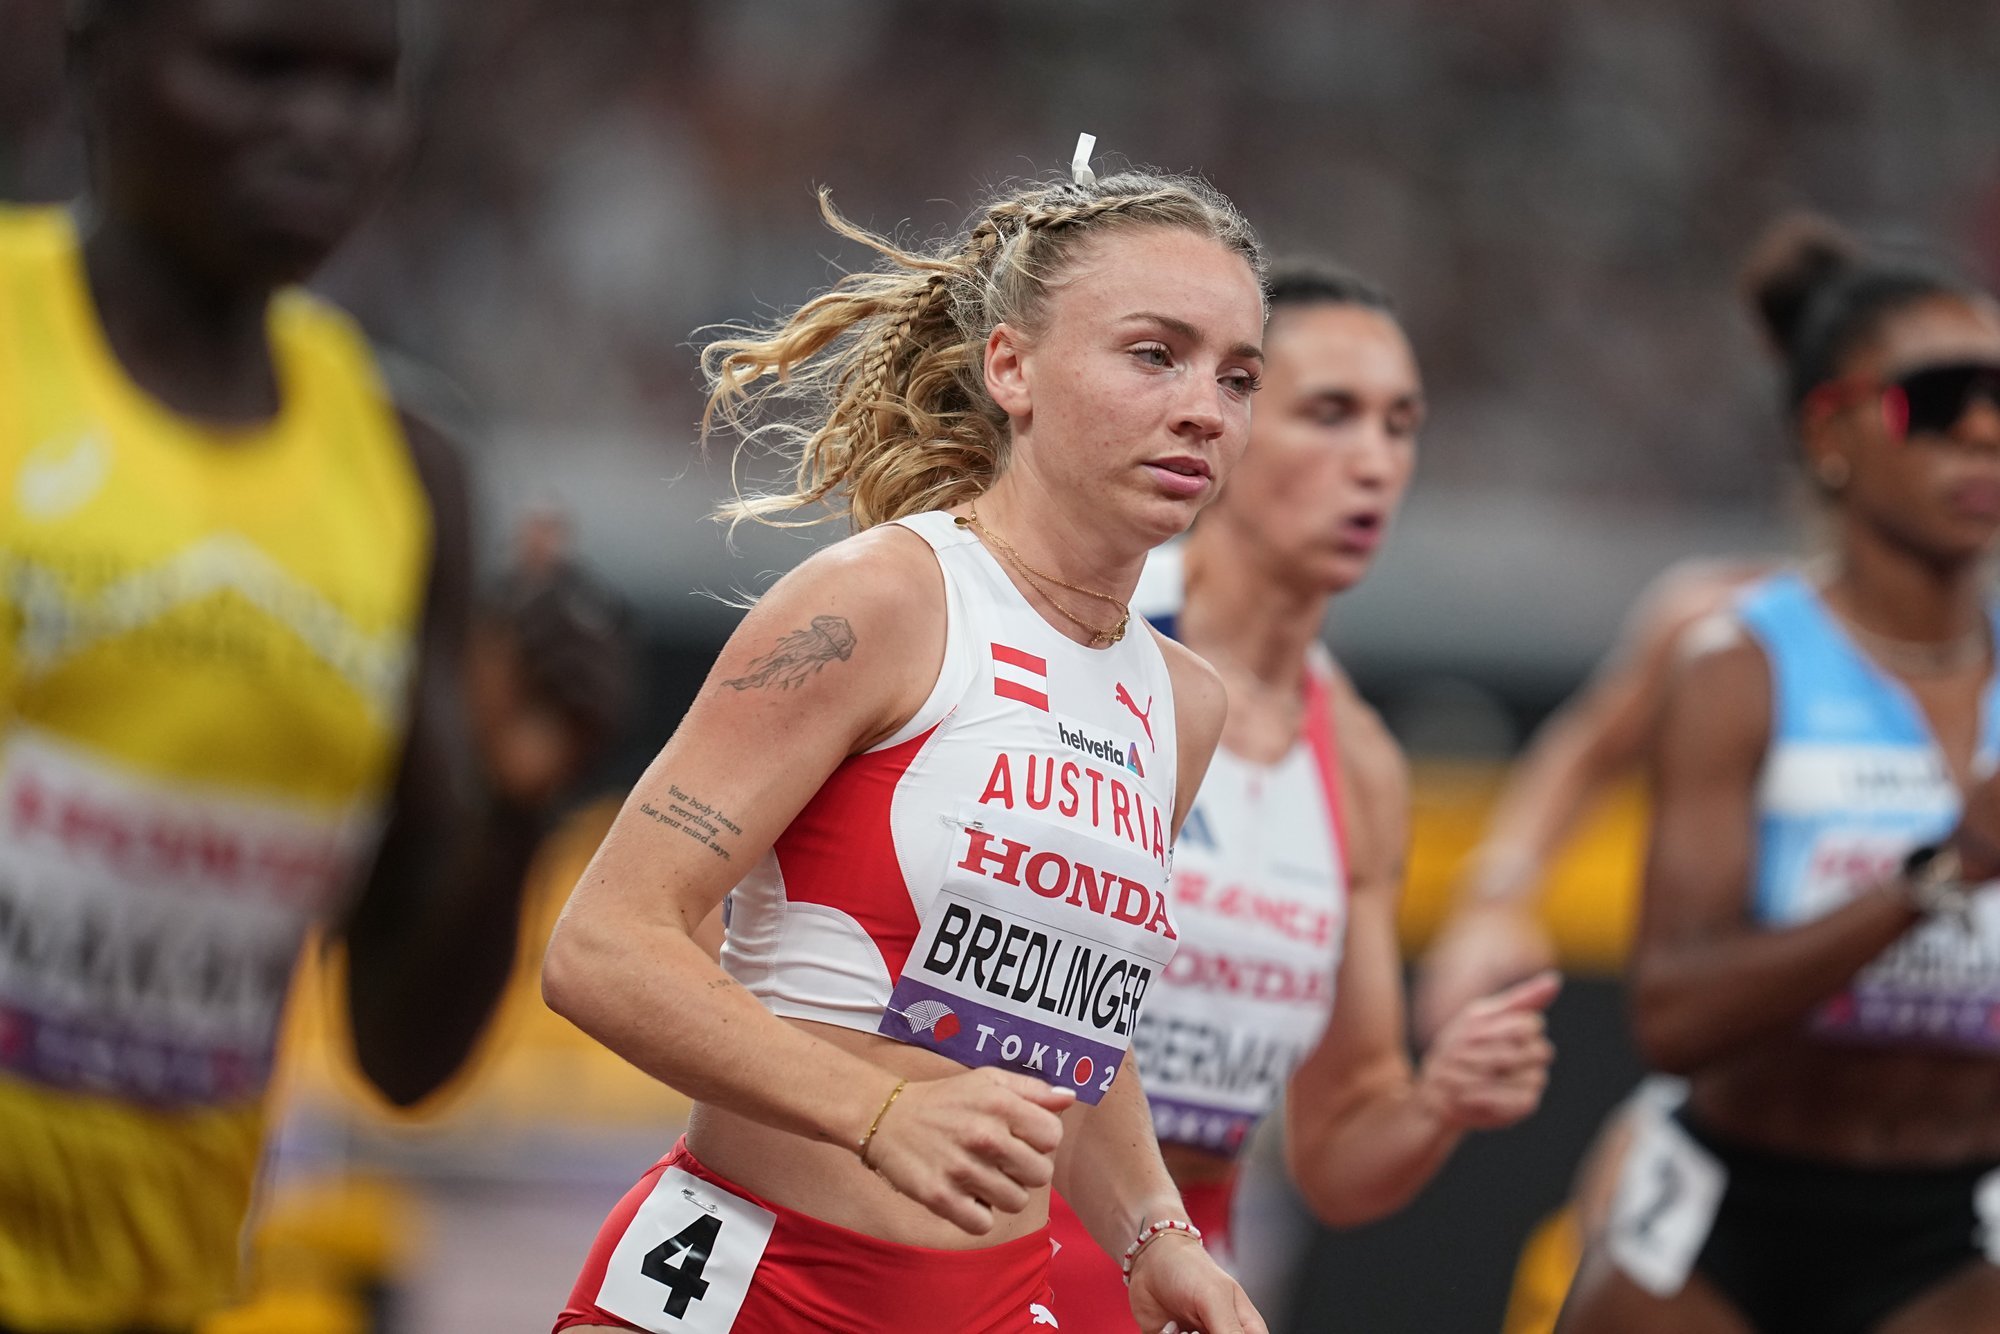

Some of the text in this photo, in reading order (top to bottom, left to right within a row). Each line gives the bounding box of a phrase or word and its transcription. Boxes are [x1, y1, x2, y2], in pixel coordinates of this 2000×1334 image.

[1058, 722, 1124, 767] helvetia
[639, 802, 659, 819] that
[656, 813, 682, 830] your
[682, 824, 711, 845] mind
[668, 784, 688, 803] Your
[688, 797, 715, 817] body
[668, 803, 720, 837] everything
[978, 753, 1164, 867] AUSTRIA
[957, 828, 1177, 941] HONDA
[923, 902, 1152, 1037] BREDLINGER
[975, 1024, 1094, 1086] TOKYO
[640, 1213, 723, 1320] 4
